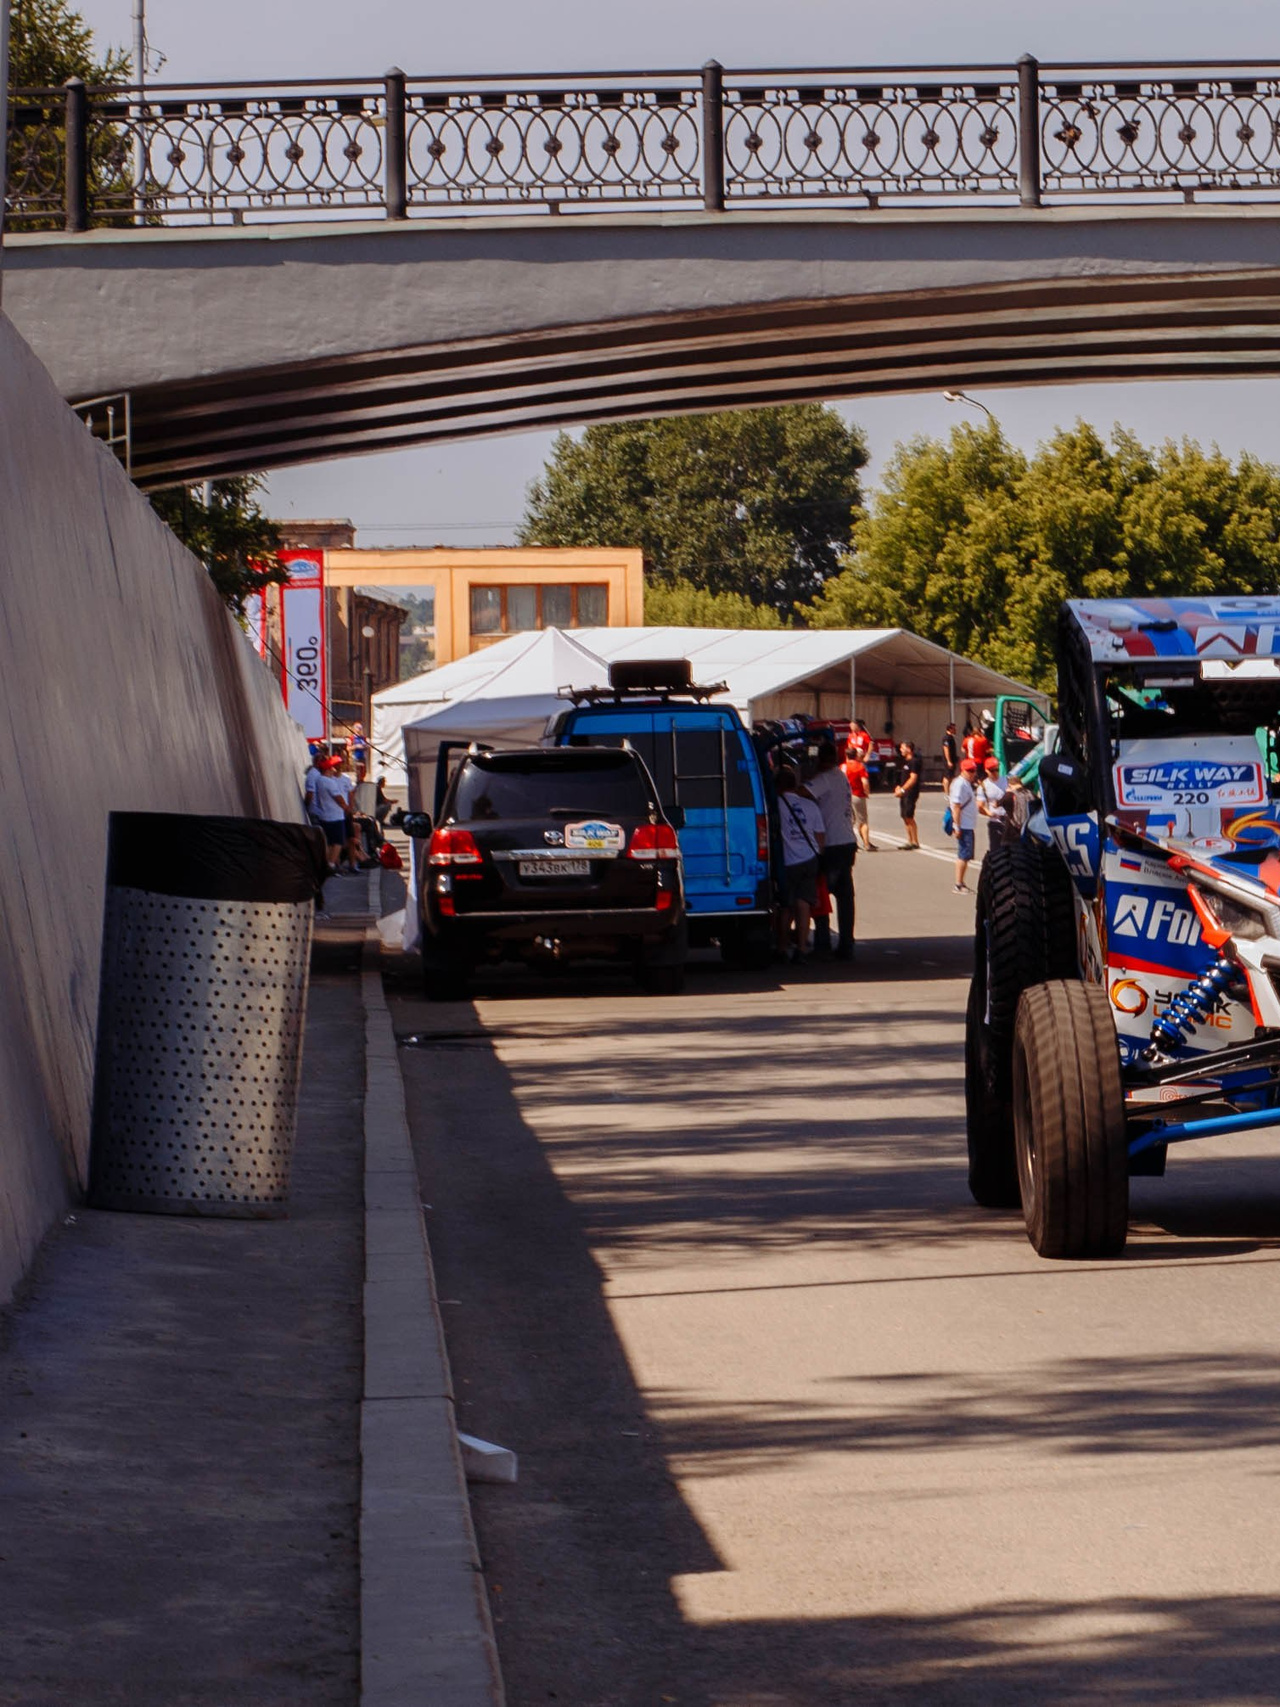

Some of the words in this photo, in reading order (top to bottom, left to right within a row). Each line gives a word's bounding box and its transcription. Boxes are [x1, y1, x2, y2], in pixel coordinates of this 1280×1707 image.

[1131, 768, 1188, 782] SILK
[1195, 766, 1247, 780] WAY
[1174, 793, 1209, 805] 220
[1154, 990, 1231, 1015] УК
